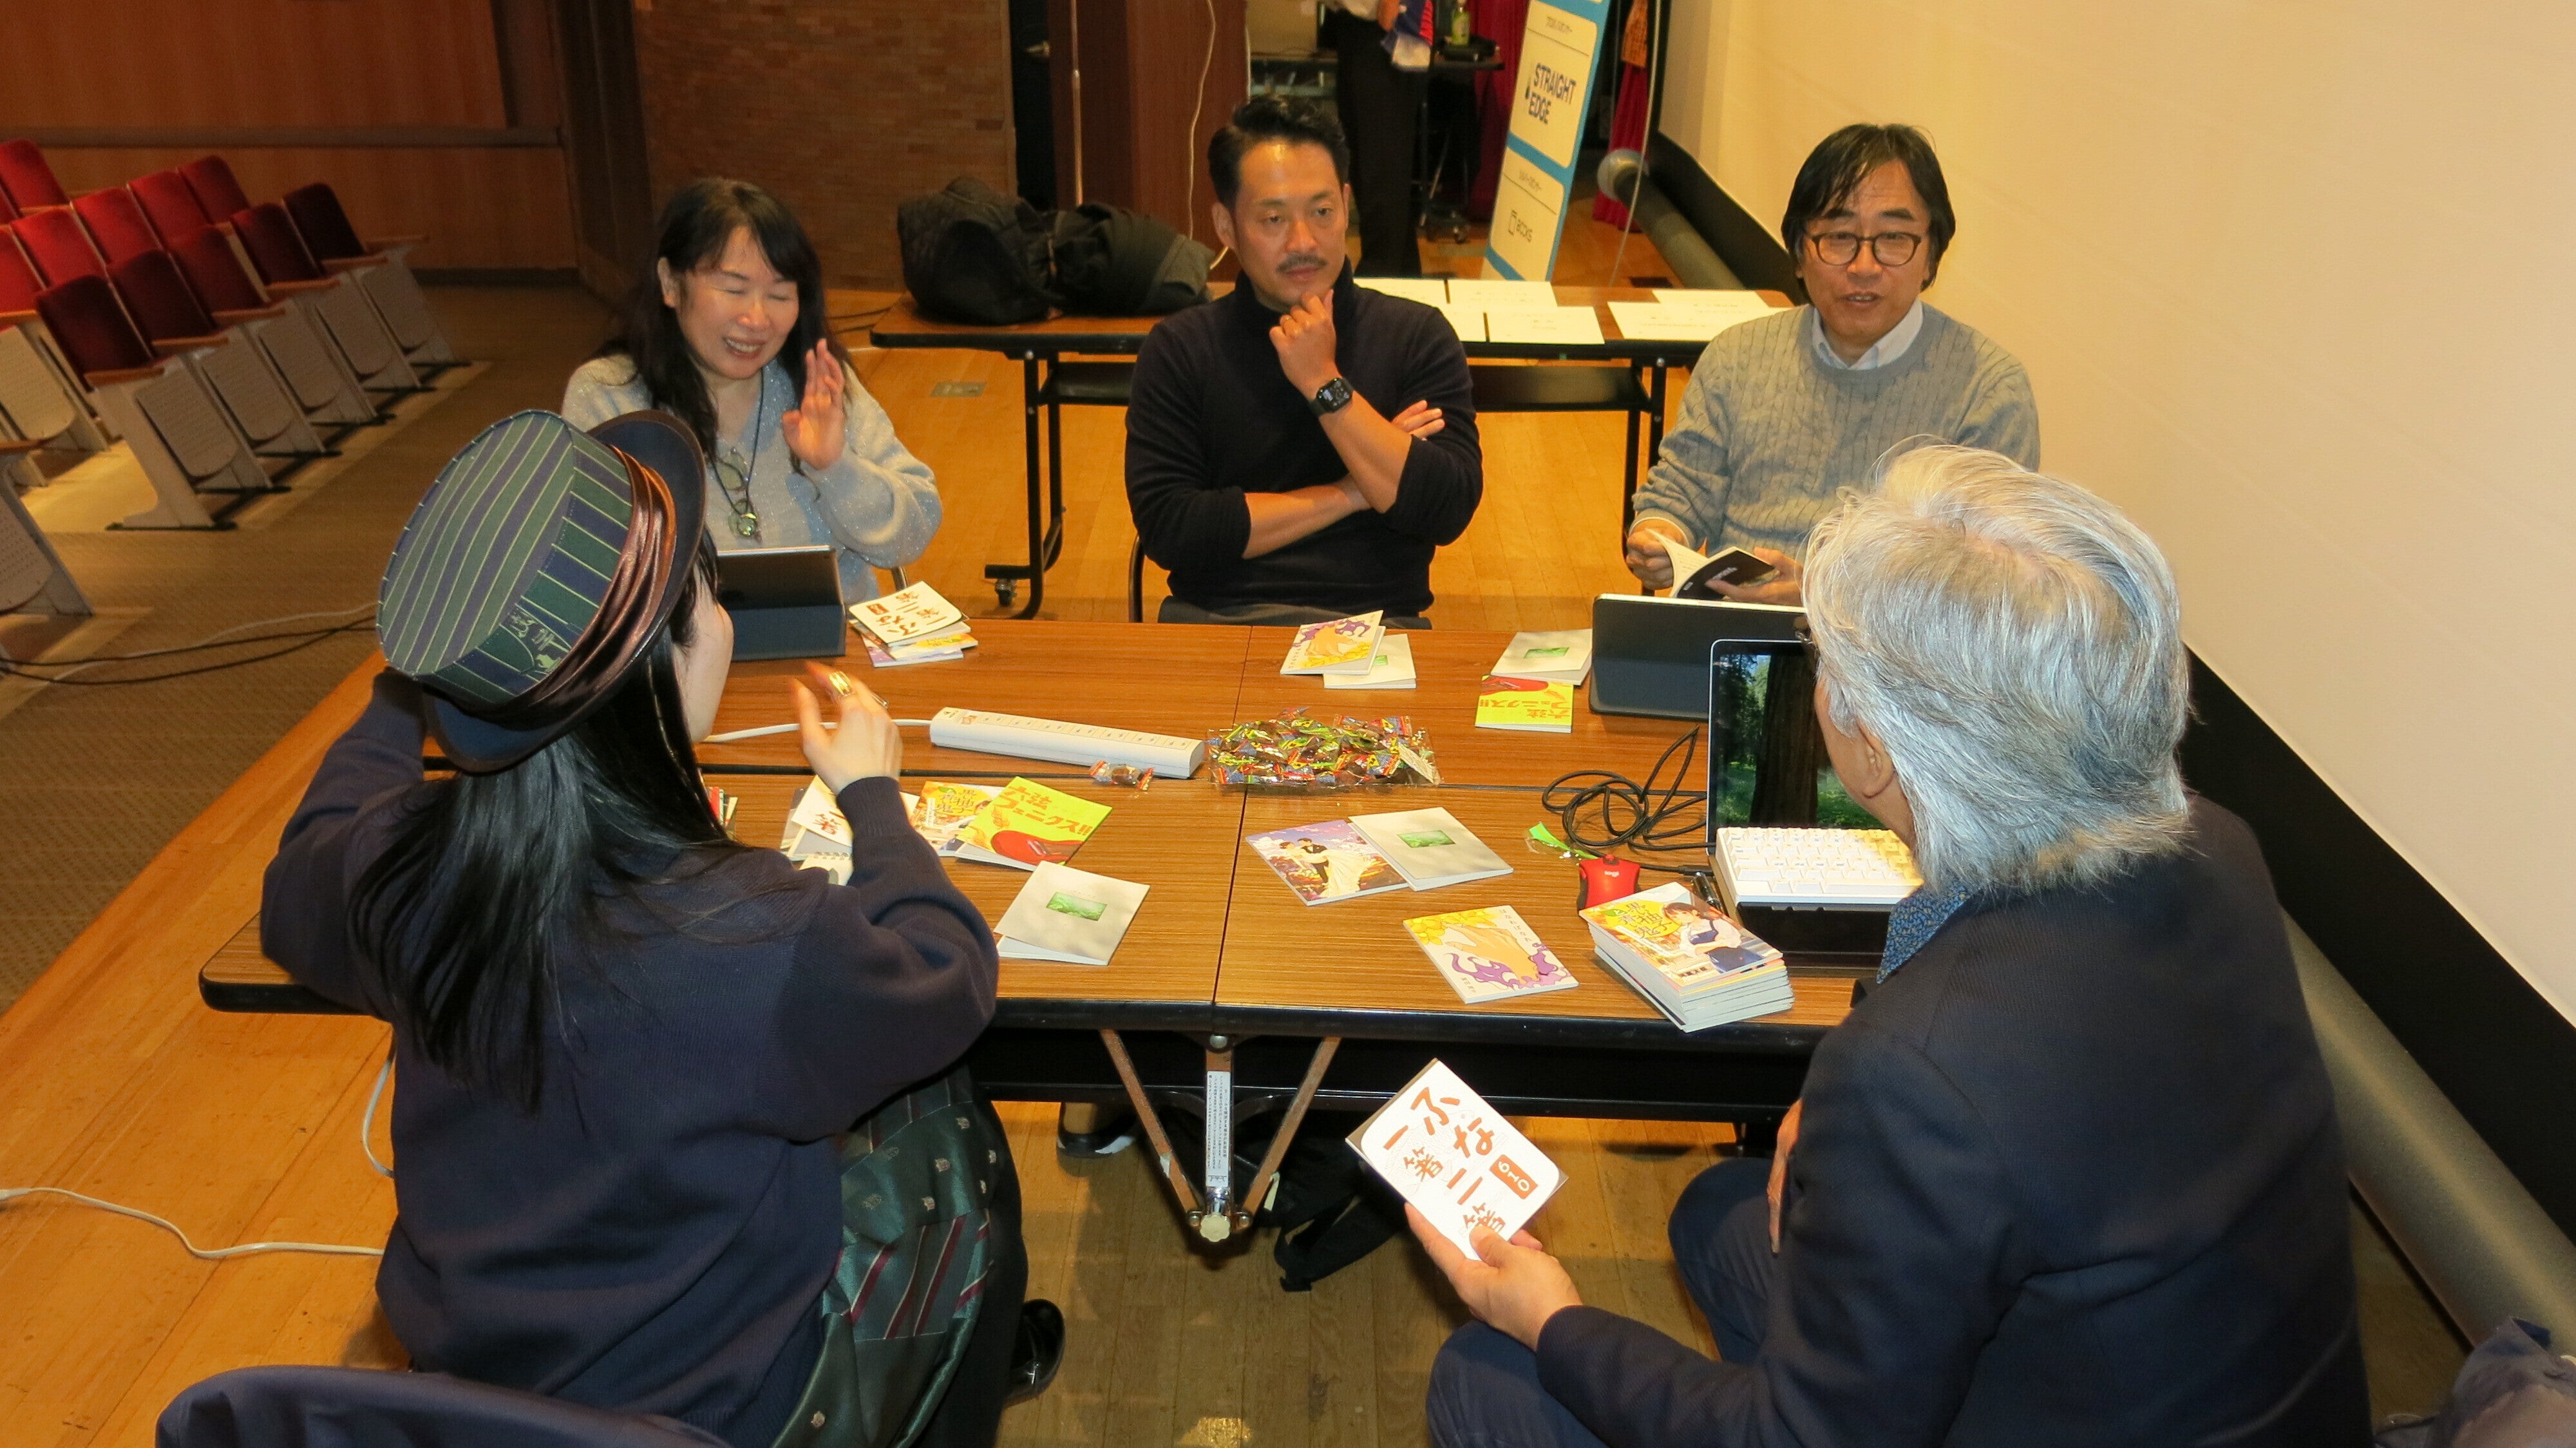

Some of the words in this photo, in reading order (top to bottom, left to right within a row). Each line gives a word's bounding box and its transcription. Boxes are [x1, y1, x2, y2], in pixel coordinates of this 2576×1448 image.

[1534, 62, 1577, 104] STRAIGHT
[1528, 91, 1551, 124] EDGE
[1003, 786, 1052, 810] 六弦
[1410, 1087, 1495, 1159] ふな
[1498, 1161, 1530, 1192] 610
